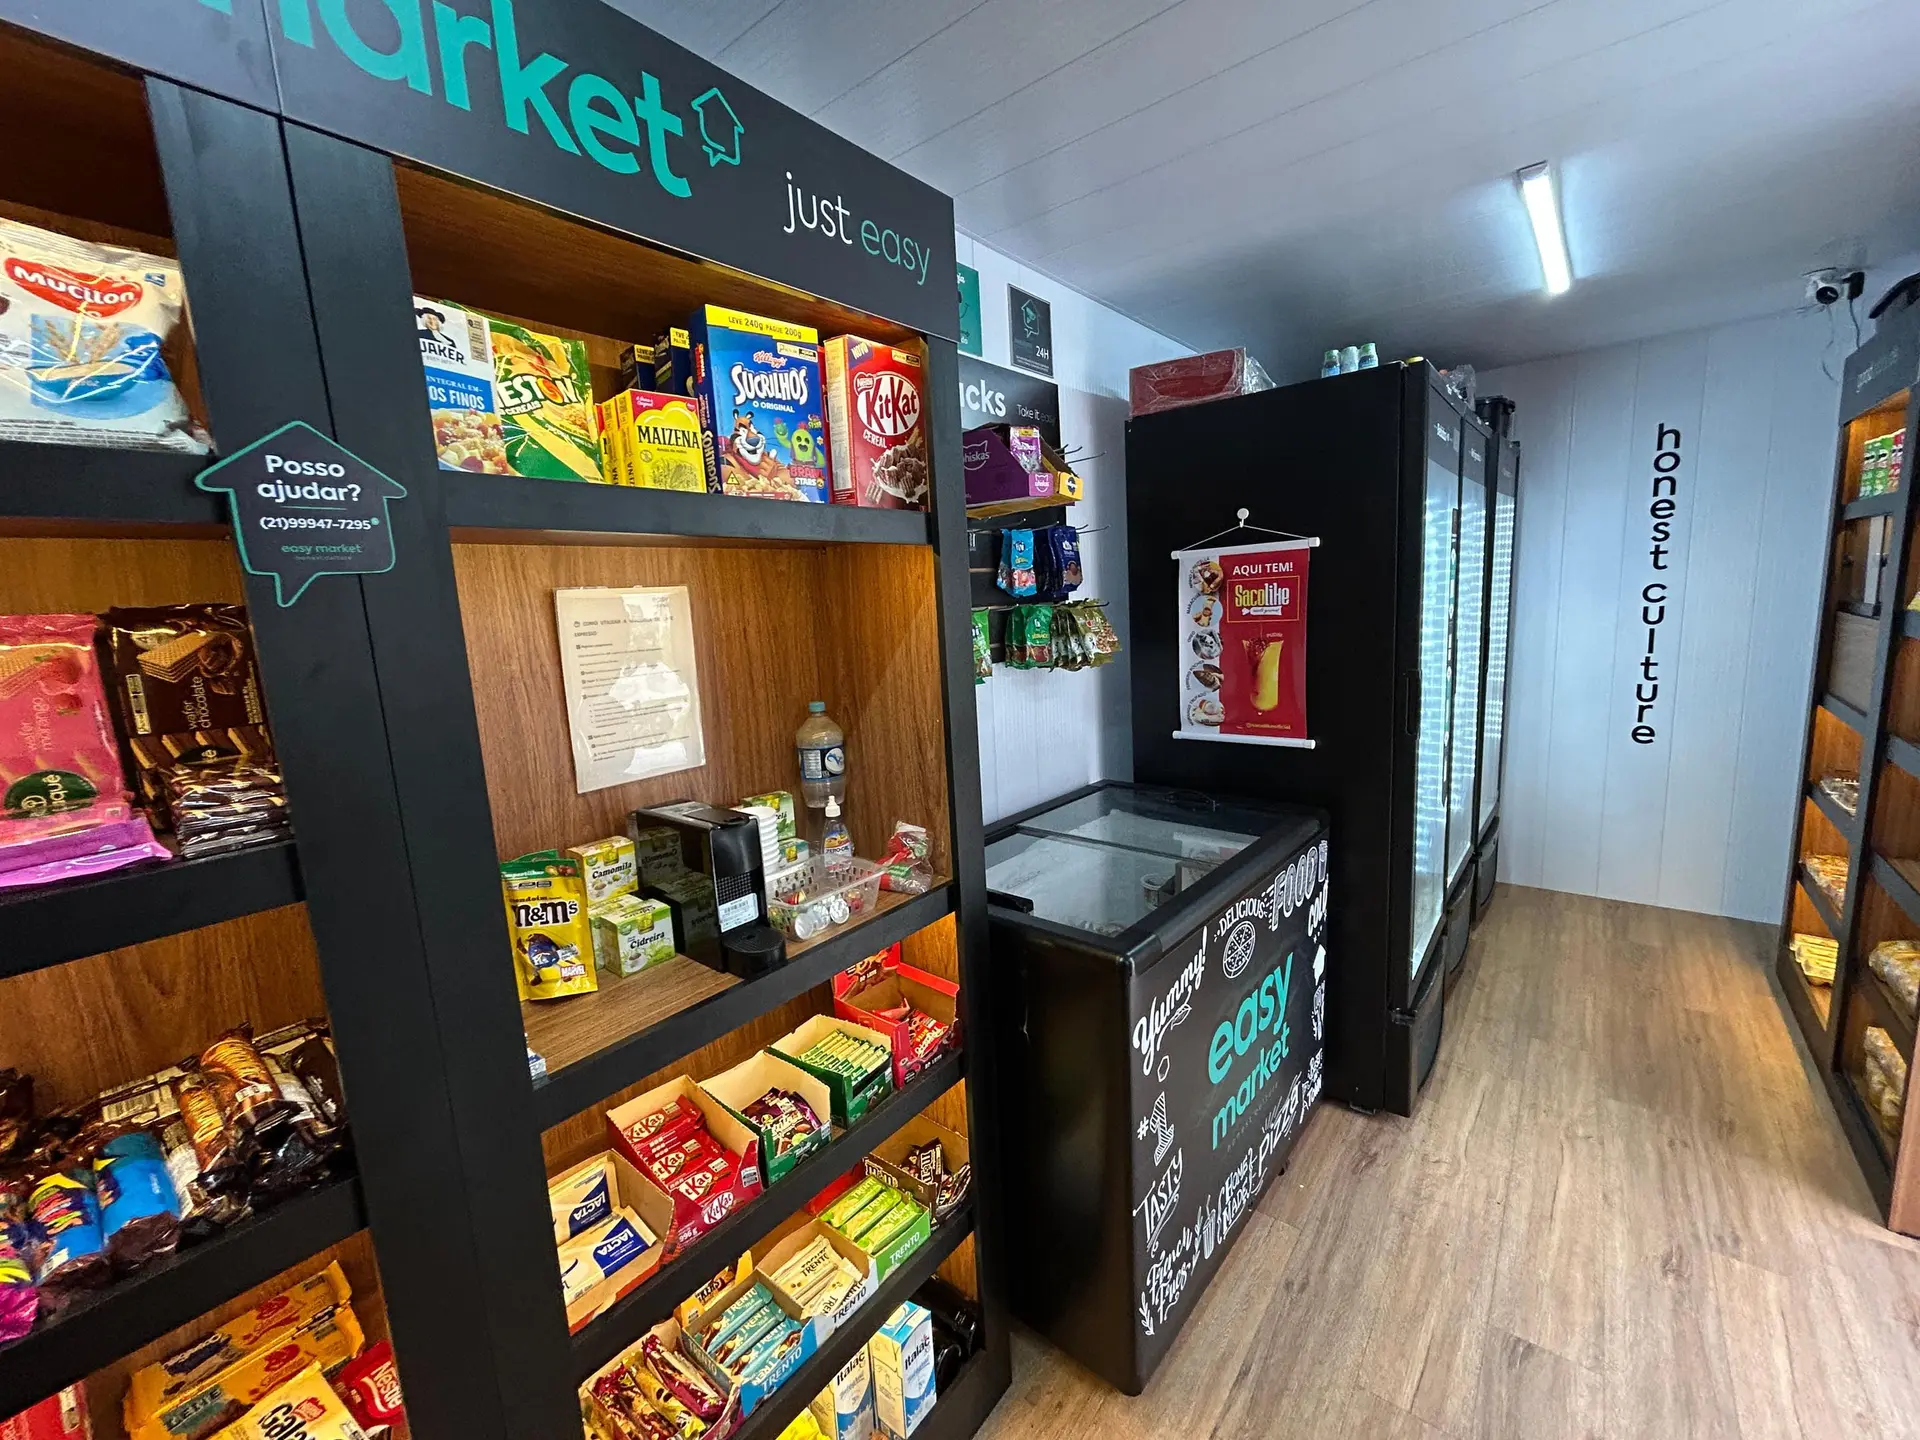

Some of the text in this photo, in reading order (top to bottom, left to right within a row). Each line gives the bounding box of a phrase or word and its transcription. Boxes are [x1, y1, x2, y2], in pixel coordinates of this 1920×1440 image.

[783, 171, 931, 285] just easy
[728, 316, 743, 325] LEVE
[744, 318, 764, 331] 240g
[784, 327, 802, 340] 200g
[420, 340, 465, 365] UAKER
[1035, 345, 1050, 360] 24H
[449, 390, 486, 410] FINOS
[497, 375, 579, 408] ESTON
[731, 364, 809, 406] SUCRILHOS
[960, 379, 1007, 418] cks
[760, 401, 796, 413] ORIGINAL
[865, 375, 918, 434] KitKat
[1016, 403, 1034, 420] Take
[637, 425, 700, 449] MAIZENA
[862, 429, 888, 449] CEREAL
[264, 455, 346, 478] Posso
[963, 451, 990, 462] hiskas
[257, 479, 362, 503] ajudar?
[259, 516, 372, 530] (21)99947-7295
[315, 543, 363, 553] market
[1232, 561, 1294, 577] AQUI TEM!
[1630, 422, 1681, 745] honest culture
[1234, 582, 1290, 608] Sacolike
[182, 700, 198, 730] wafer
[190, 676, 212, 729] chocolate
[591, 862, 632, 879] Camomila
[1271, 846, 1319, 932] FOOD
[1218, 897, 1266, 937] DELICIOUS
[630, 931, 665, 950] Cidreira
[1132, 925, 1208, 1076] Yummy!
[1208, 951, 1294, 1085] easy
[1213, 1021, 1290, 1150] market
[573, 1190, 606, 1221] LACTA
[704, 1193, 733, 1224] KitKat
[1132, 1147, 1183, 1243] TASTY
[597, 1228, 635, 1256] LACTA
[889, 1232, 920, 1265] TRENTO
[832, 1286, 867, 1324] TRENTO
[836, 1350, 866, 1386] Italac
[904, 1335, 930, 1370] Italac
[761, 1346, 802, 1392] TRENTO
